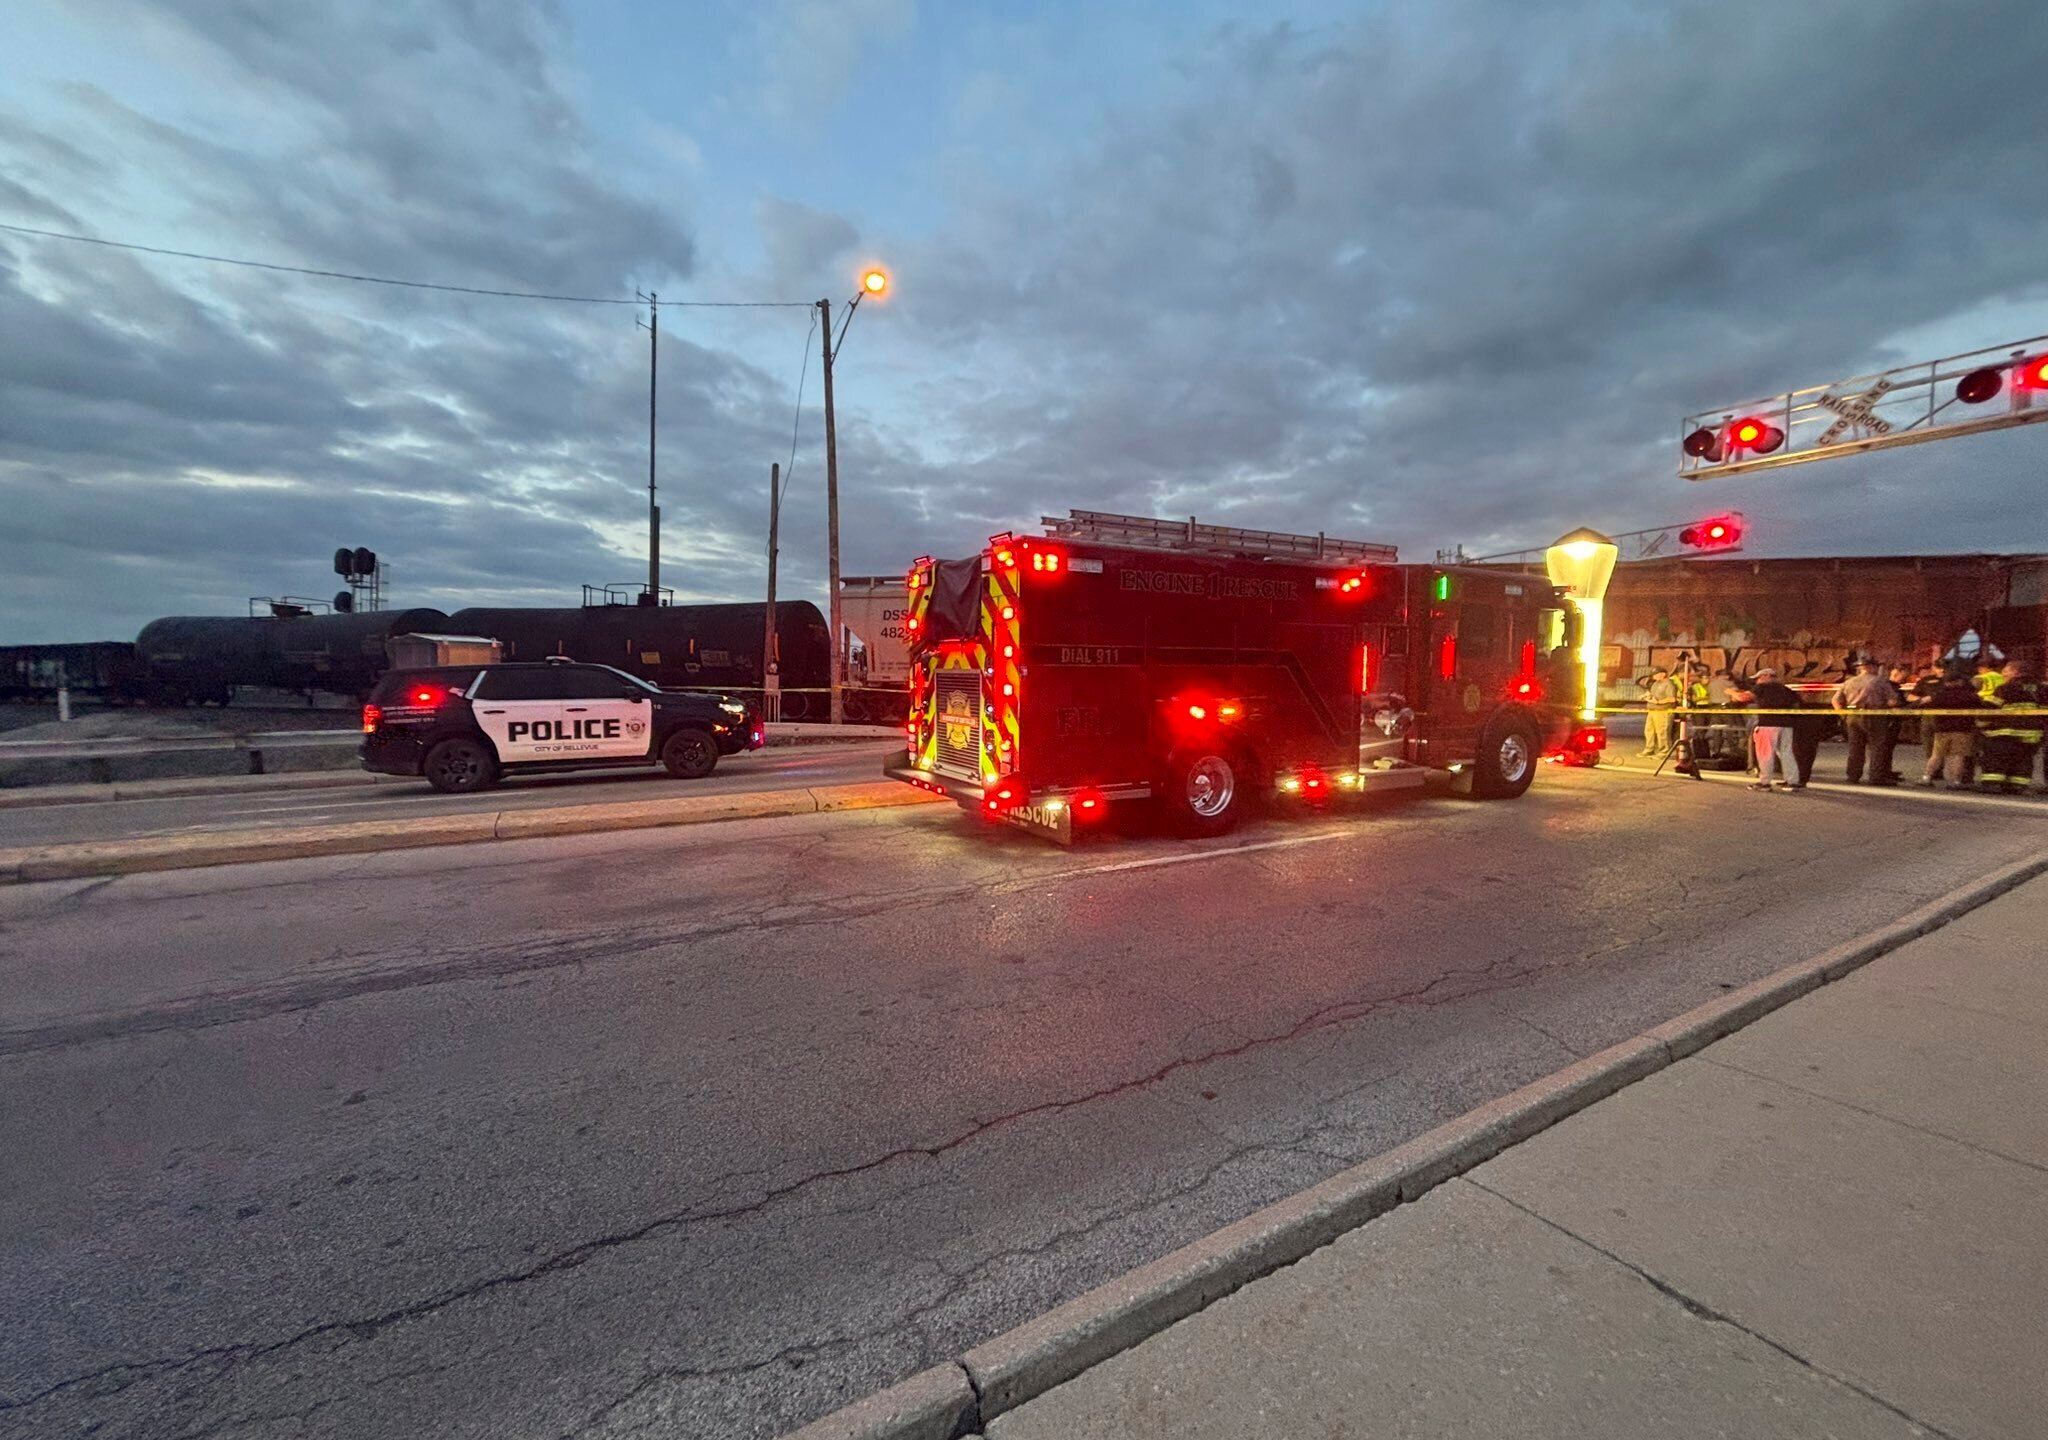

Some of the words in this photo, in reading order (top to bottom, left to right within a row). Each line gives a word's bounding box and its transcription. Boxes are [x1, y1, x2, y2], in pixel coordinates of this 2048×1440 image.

[1820, 381, 1890, 444] CROSSING
[1120, 569, 1204, 595] ENGINE
[1207, 572, 1222, 600] 1
[1223, 577, 1298, 600] RESCUE
[1061, 648, 1092, 663] DIAL
[1096, 649, 1119, 664] 911
[508, 719, 620, 742] POLICE
